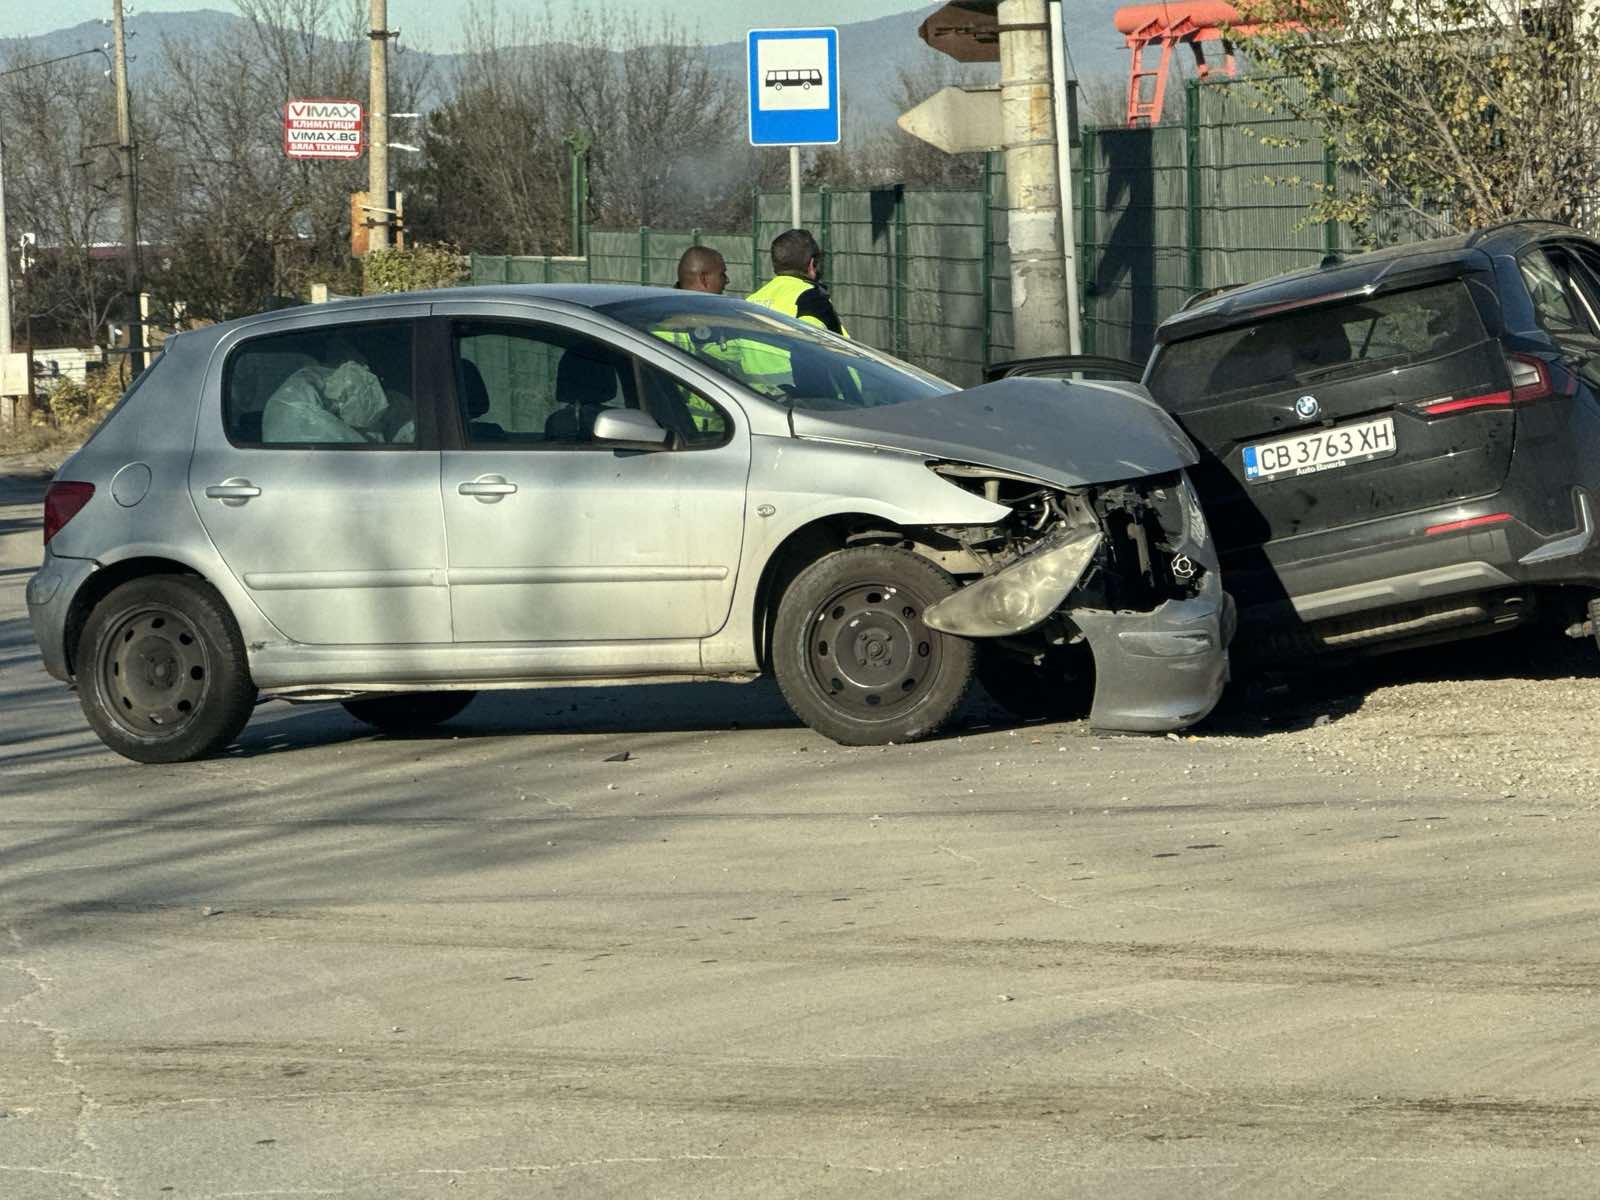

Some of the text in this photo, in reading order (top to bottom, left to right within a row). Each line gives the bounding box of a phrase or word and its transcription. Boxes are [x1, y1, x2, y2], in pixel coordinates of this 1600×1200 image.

[291, 105, 357, 118] VIMAX
[292, 120, 355, 129] КЛИМАТИЦИ
[291, 132, 357, 142] VIMAX.BG
[1261, 423, 1390, 471] CB 3763 XH
[1296, 460, 1347, 476] Auto Bavaria
